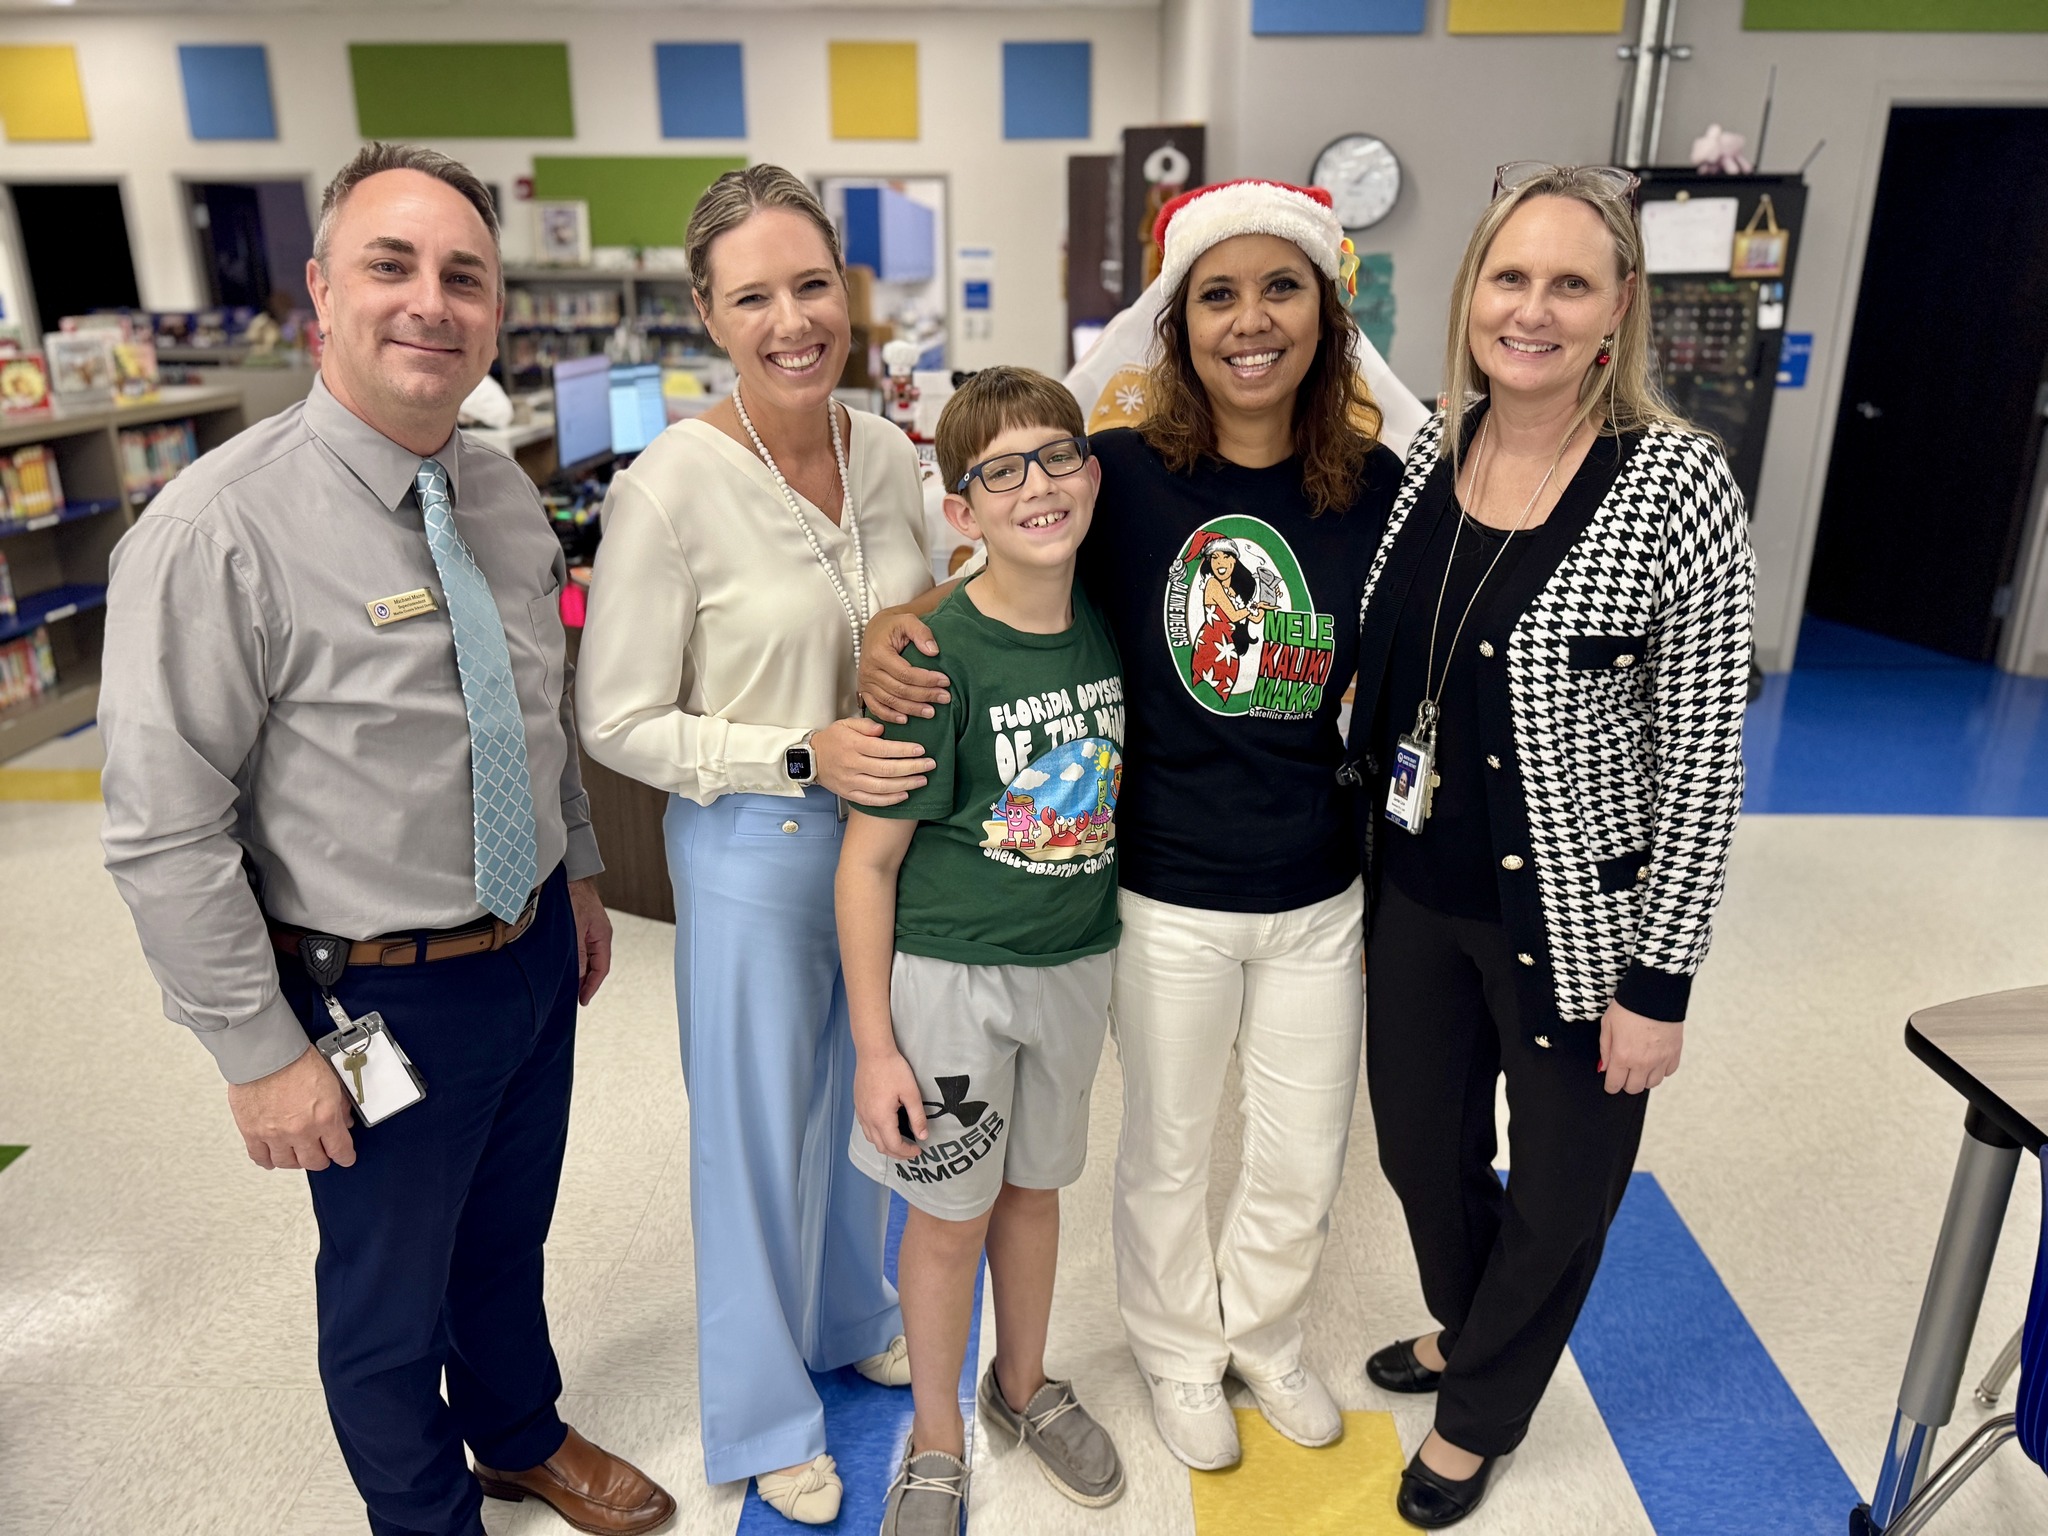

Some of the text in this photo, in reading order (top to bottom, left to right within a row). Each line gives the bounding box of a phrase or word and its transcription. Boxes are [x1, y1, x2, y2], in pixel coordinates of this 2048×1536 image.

[1168, 592, 1187, 613] KINE
[1168, 613, 1190, 647] DIEGO'S
[1264, 610, 1333, 651] MELE
[1258, 641, 1332, 686] KALIKI
[1076, 675, 1124, 712] ODYSSE
[1250, 676, 1322, 713] MAKA
[1249, 707, 1314, 721] Satellite Beach FL
[995, 704, 1126, 787] OF THE MiN
[894, 1118, 1004, 1184] ARMOUR
